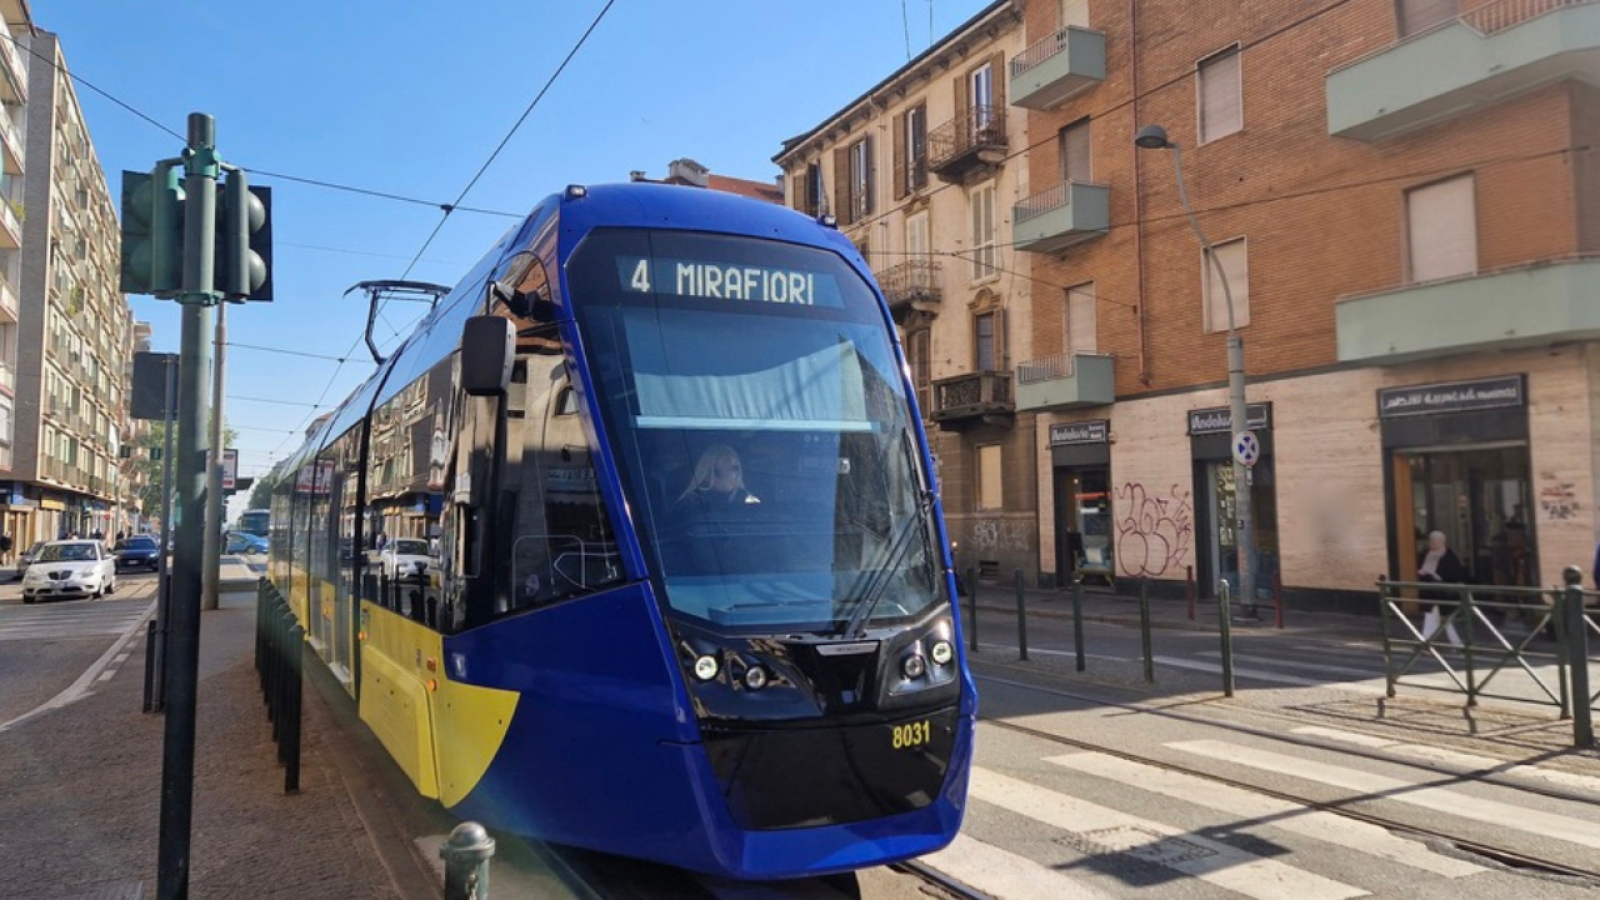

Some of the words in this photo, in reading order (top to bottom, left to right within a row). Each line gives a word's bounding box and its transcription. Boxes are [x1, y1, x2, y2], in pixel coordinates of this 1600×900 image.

[631, 259, 650, 293] 4
[677, 263, 813, 305] MIRAFIORI
[892, 720, 931, 748] 8031
